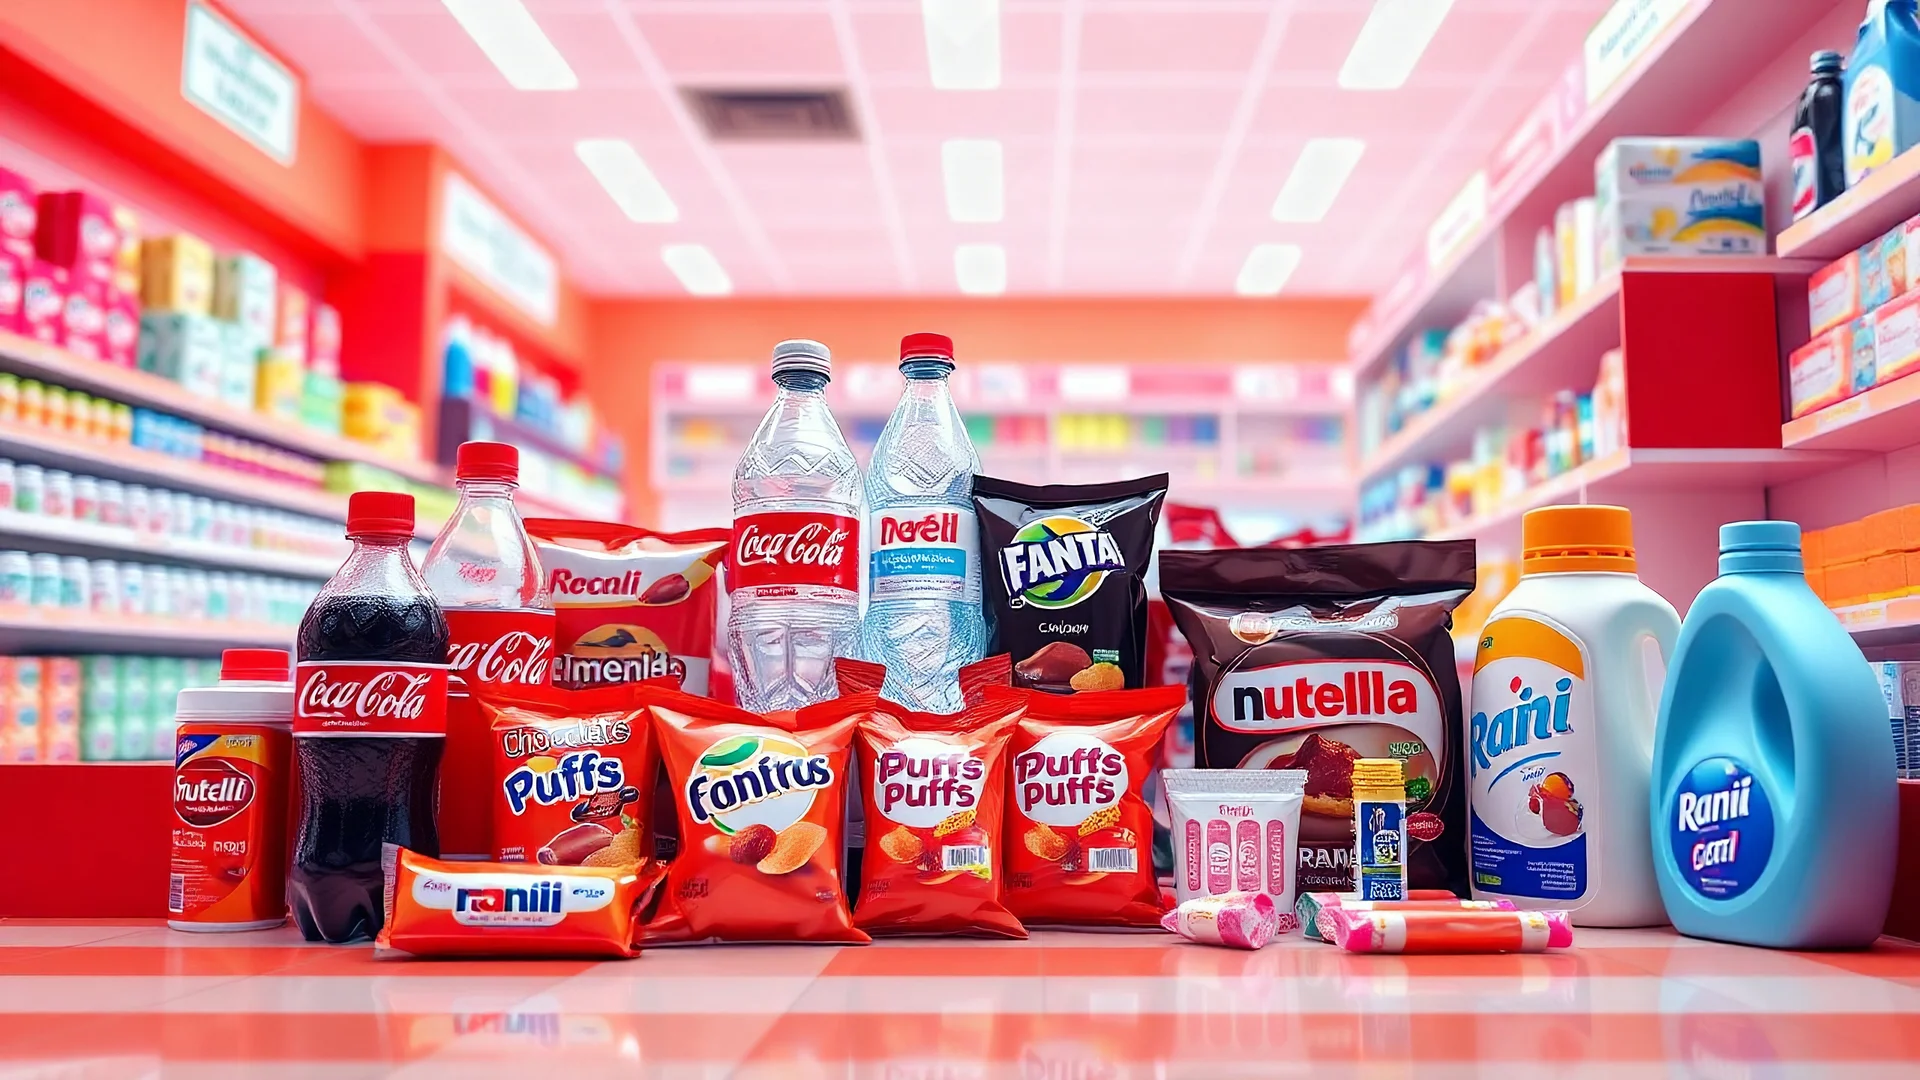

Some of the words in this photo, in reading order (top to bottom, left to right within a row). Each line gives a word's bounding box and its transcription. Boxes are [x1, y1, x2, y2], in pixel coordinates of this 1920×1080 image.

[1003, 531, 1126, 592] FANTA
[504, 753, 625, 816] Puffs
[878, 752, 984, 783] Puffs
[1015, 747, 1123, 784] Puffs
